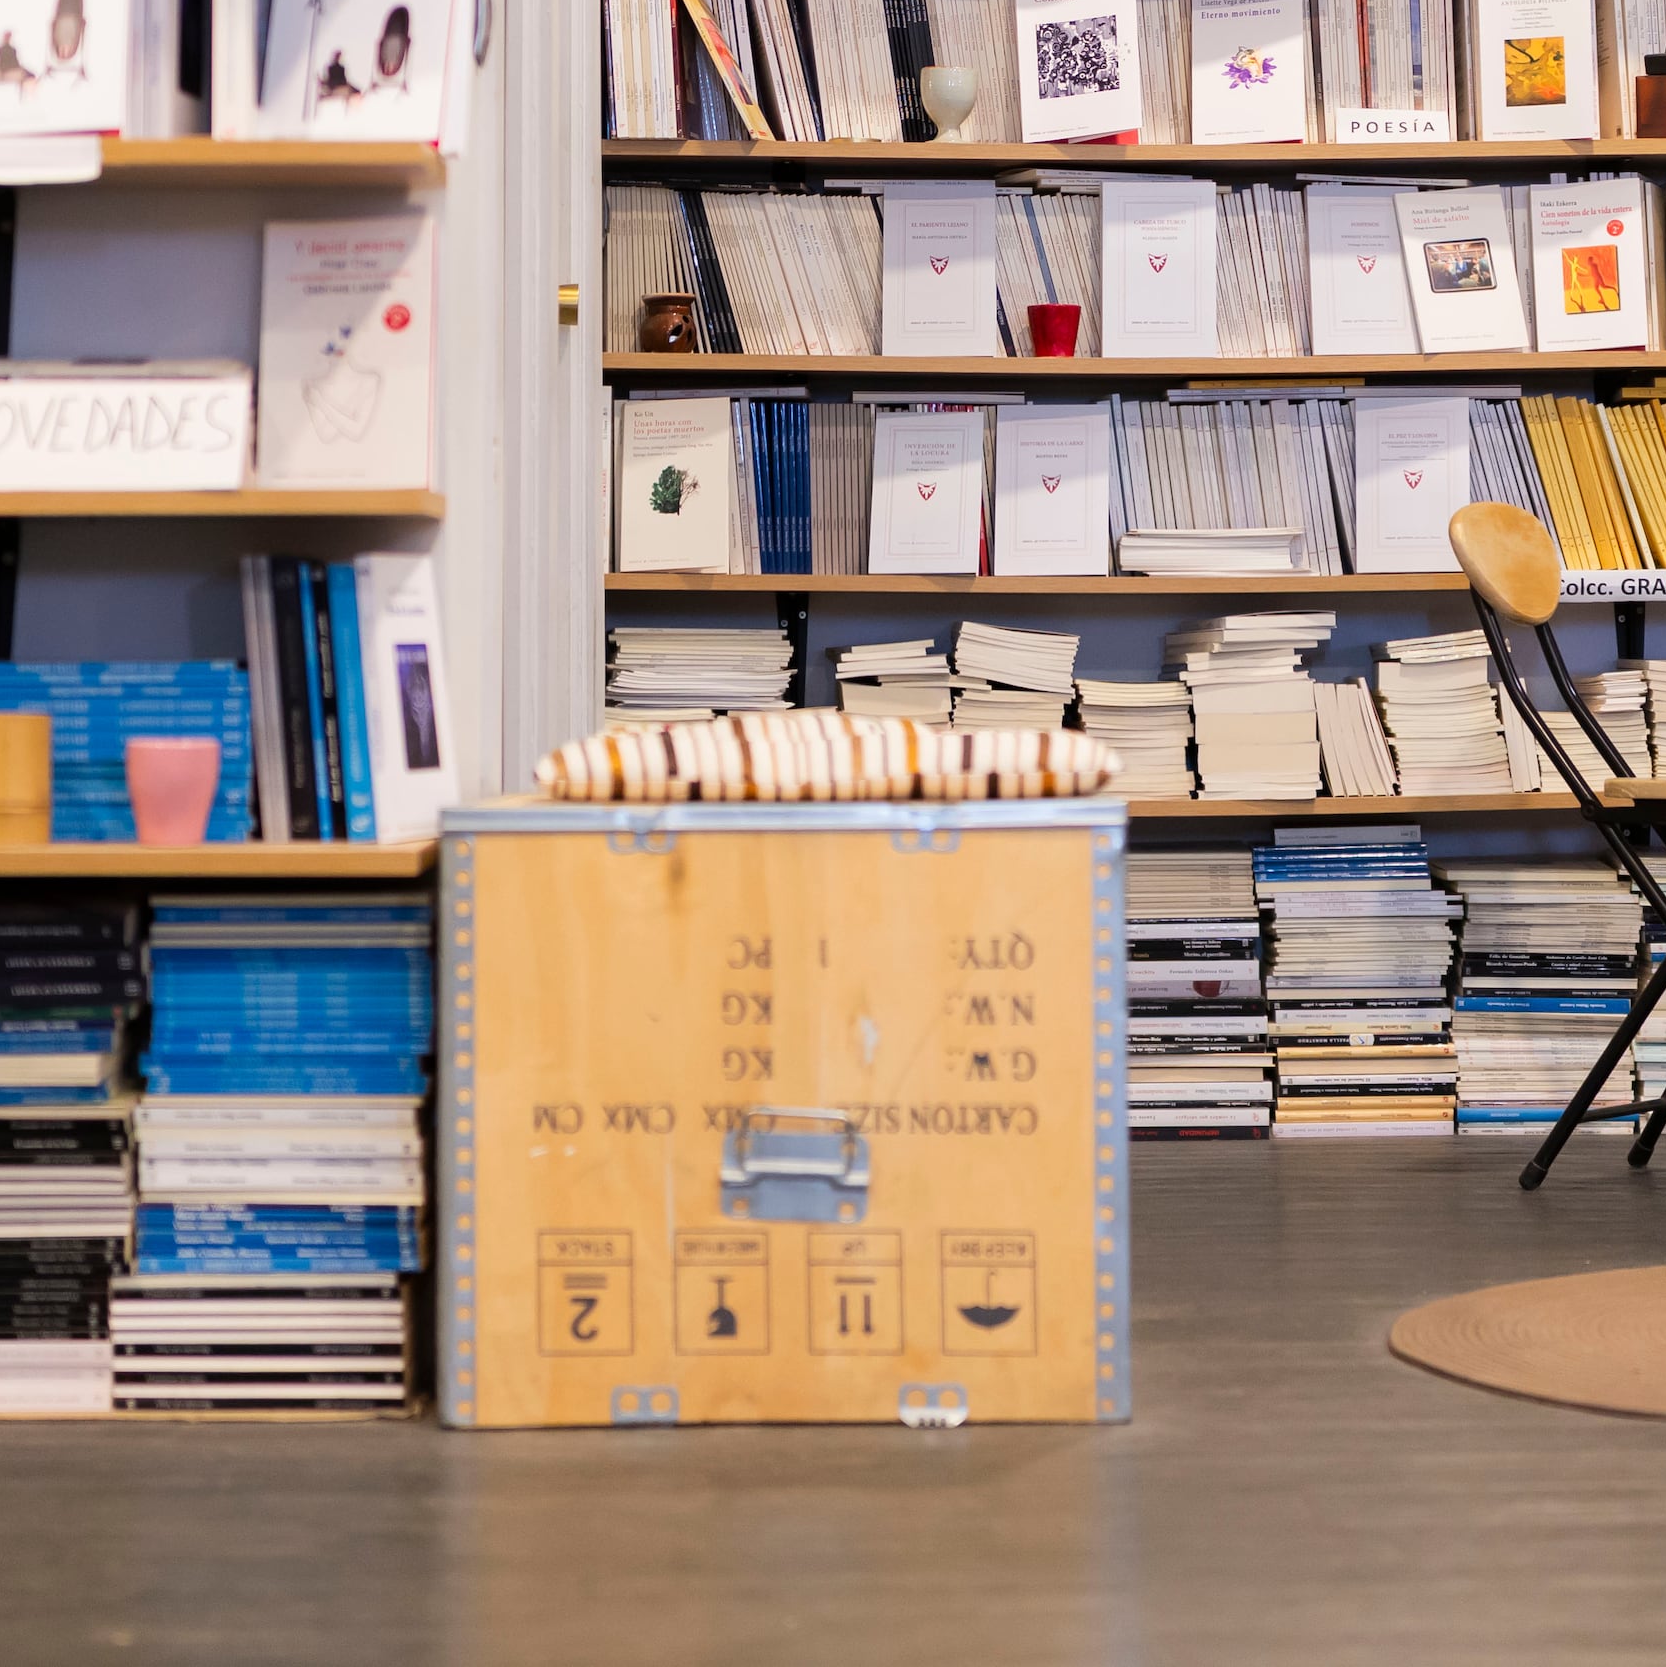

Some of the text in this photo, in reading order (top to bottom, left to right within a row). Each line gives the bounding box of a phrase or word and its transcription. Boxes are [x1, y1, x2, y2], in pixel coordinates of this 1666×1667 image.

[1201, 7, 1281, 21] Eterno movimiento
[1350, 118, 1435, 133] POESÍA
[1540, 205, 1633, 219] Cien sonetos de la vida entera
[633, 419, 692, 428] Unas horas con
[633, 425, 704, 437] los poetas muertos
[728, 938, 772, 969] PC
[947, 930, 1035, 969] QTY:
[720, 993, 773, 1024] KG
[721, 1050, 774, 1080] KG
[533, 1105, 585, 1134] CM
[602, 1105, 676, 1134] CMX
[908, 1106, 1039, 1134] CARTON
[555, 1239, 617, 1255] STACK
[567, 1297, 599, 1342] 2
